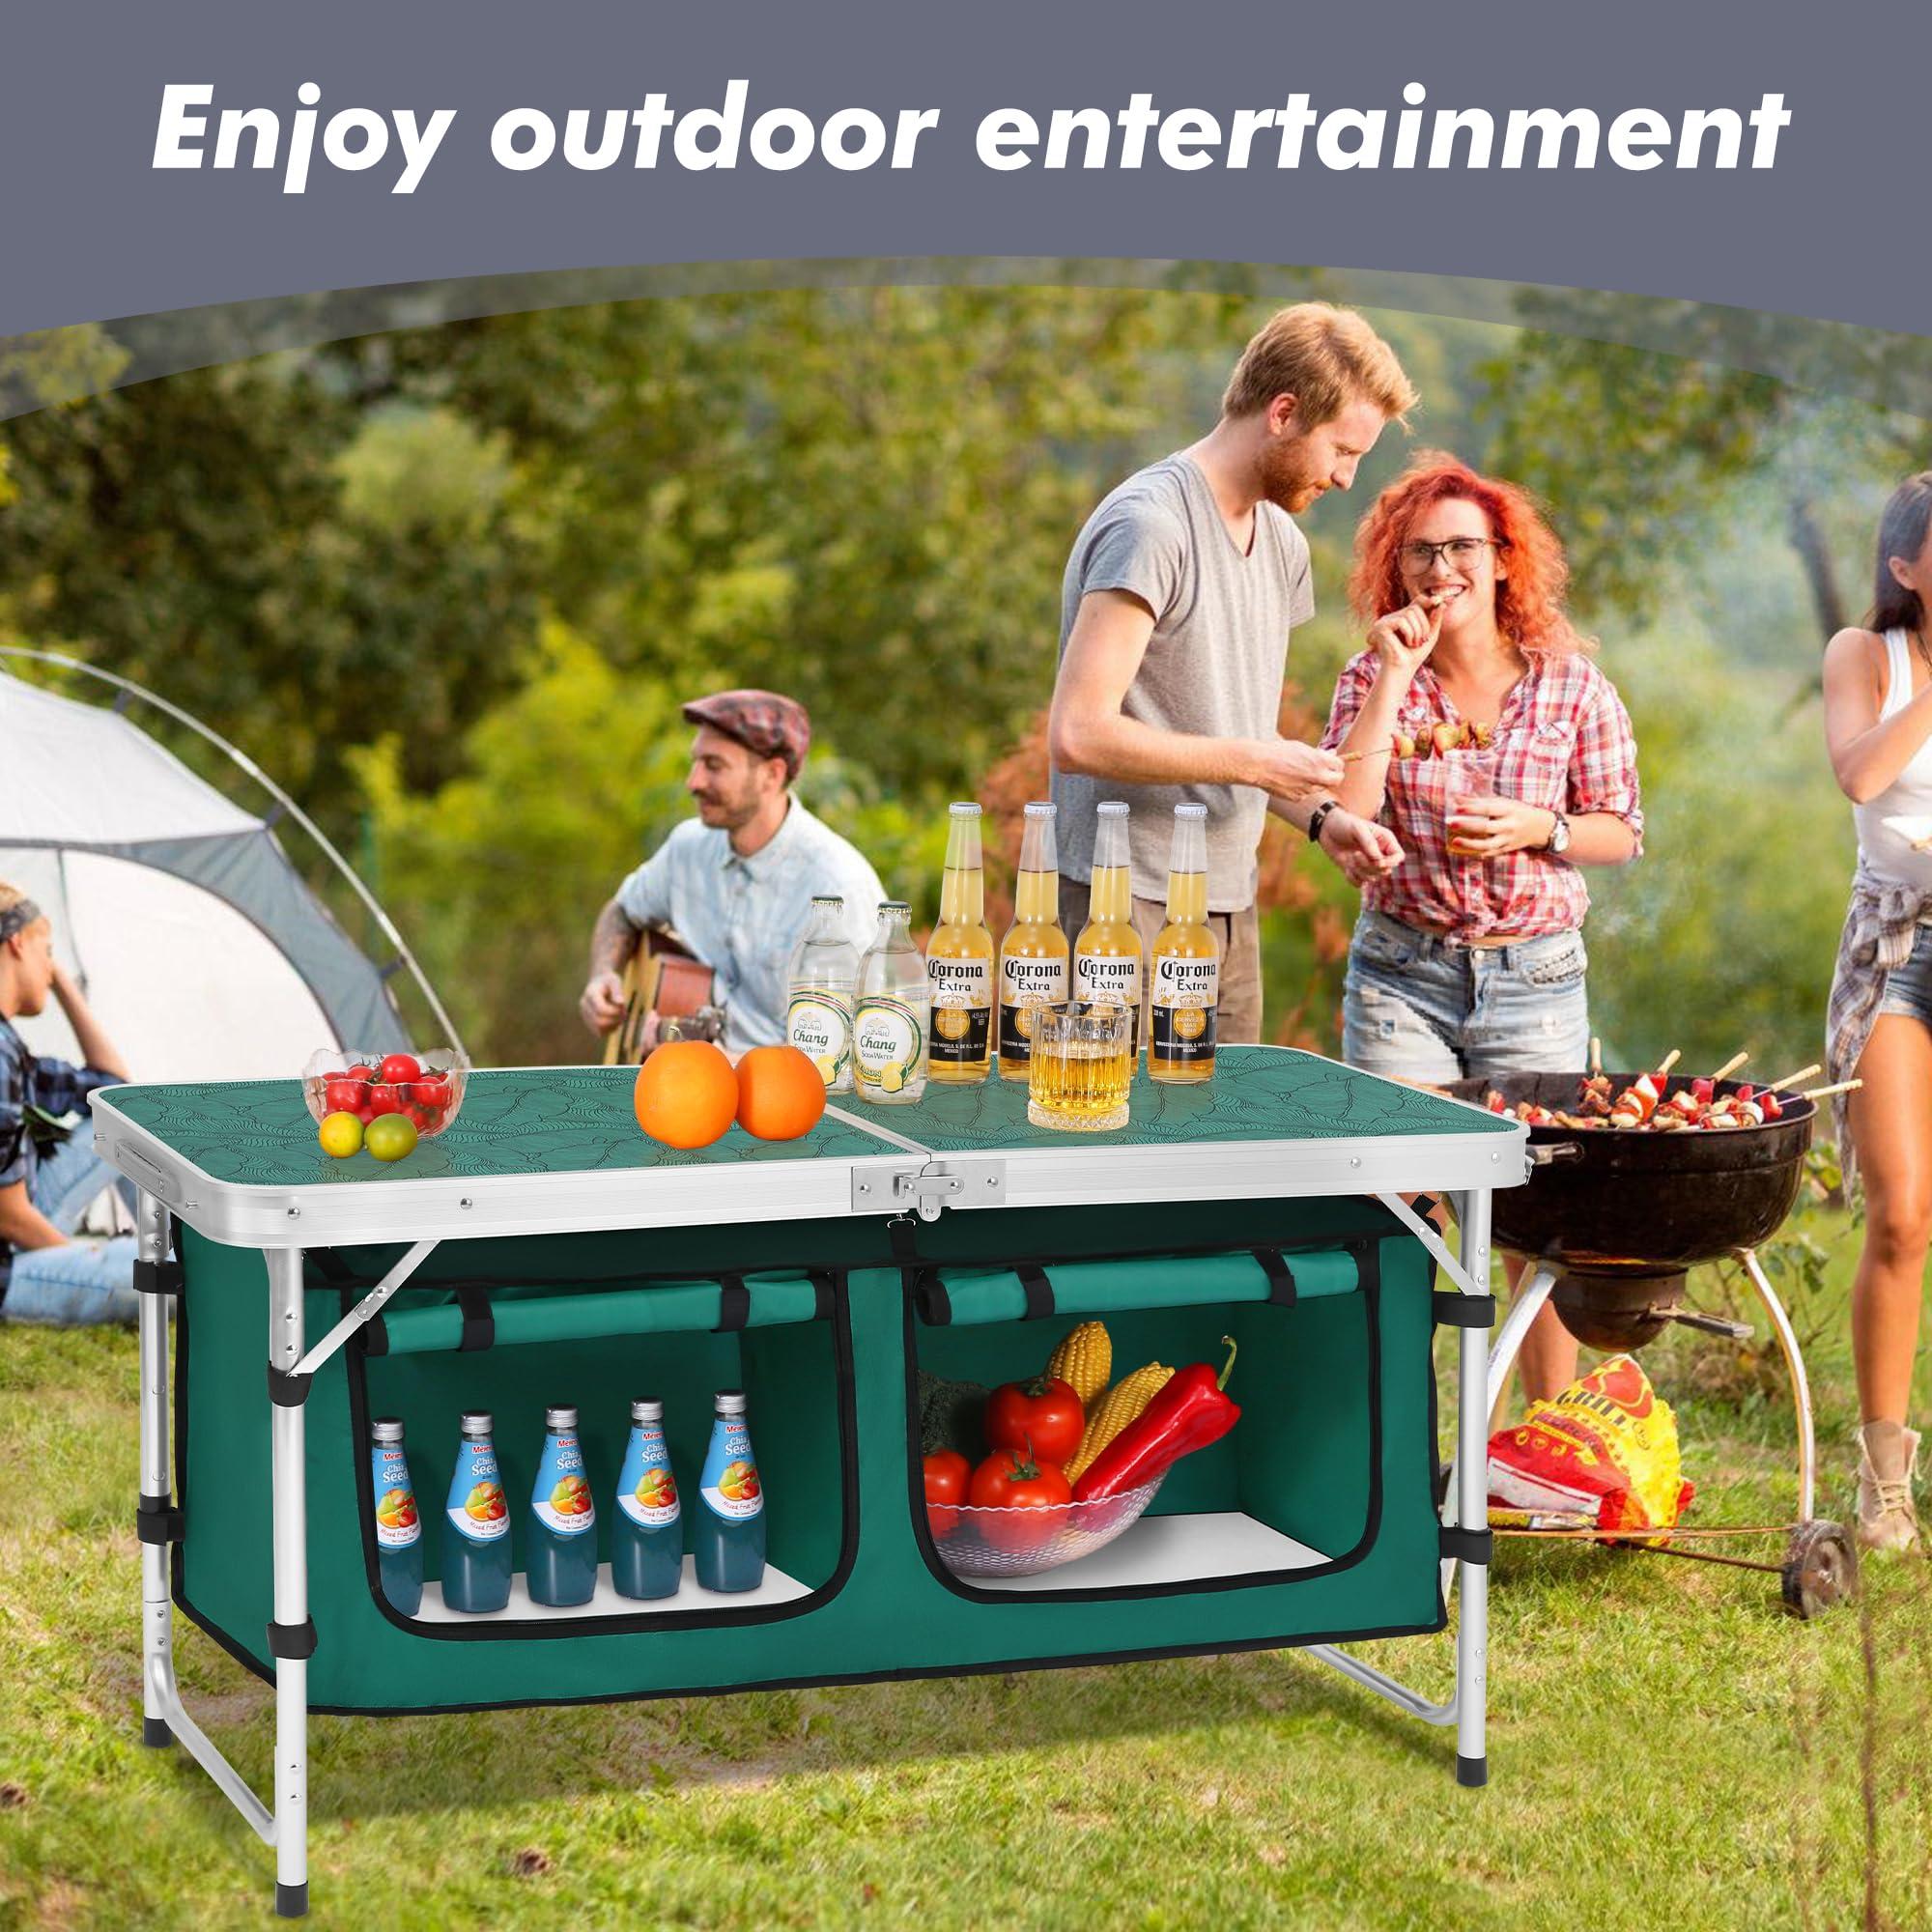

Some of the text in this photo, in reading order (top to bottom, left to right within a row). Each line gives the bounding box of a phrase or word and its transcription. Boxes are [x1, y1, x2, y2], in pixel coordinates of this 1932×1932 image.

[928, 959, 983, 980] Corona
[1005, 959, 1061, 980] Corona
[1078, 958, 1134, 979] Corona
[1161, 960, 1216, 980] Corona
[939, 978, 971, 991] Extra
[1018, 978, 1050, 991] Extra
[1092, 977, 1123, 989] Extra
[1178, 979, 1208, 991] Extra
[794, 1029, 828, 1046] Chang
[861, 1036, 896, 1052] Chang
[642, 1447, 668, 1462] Seed
[725, 1440, 751, 1456] Seed
[387, 1463, 404, 1472] Chia
[471, 1461, 497, 1476] Seed
[557, 1454, 582, 1469] Seed
[383, 1466, 408, 1483] Seed
